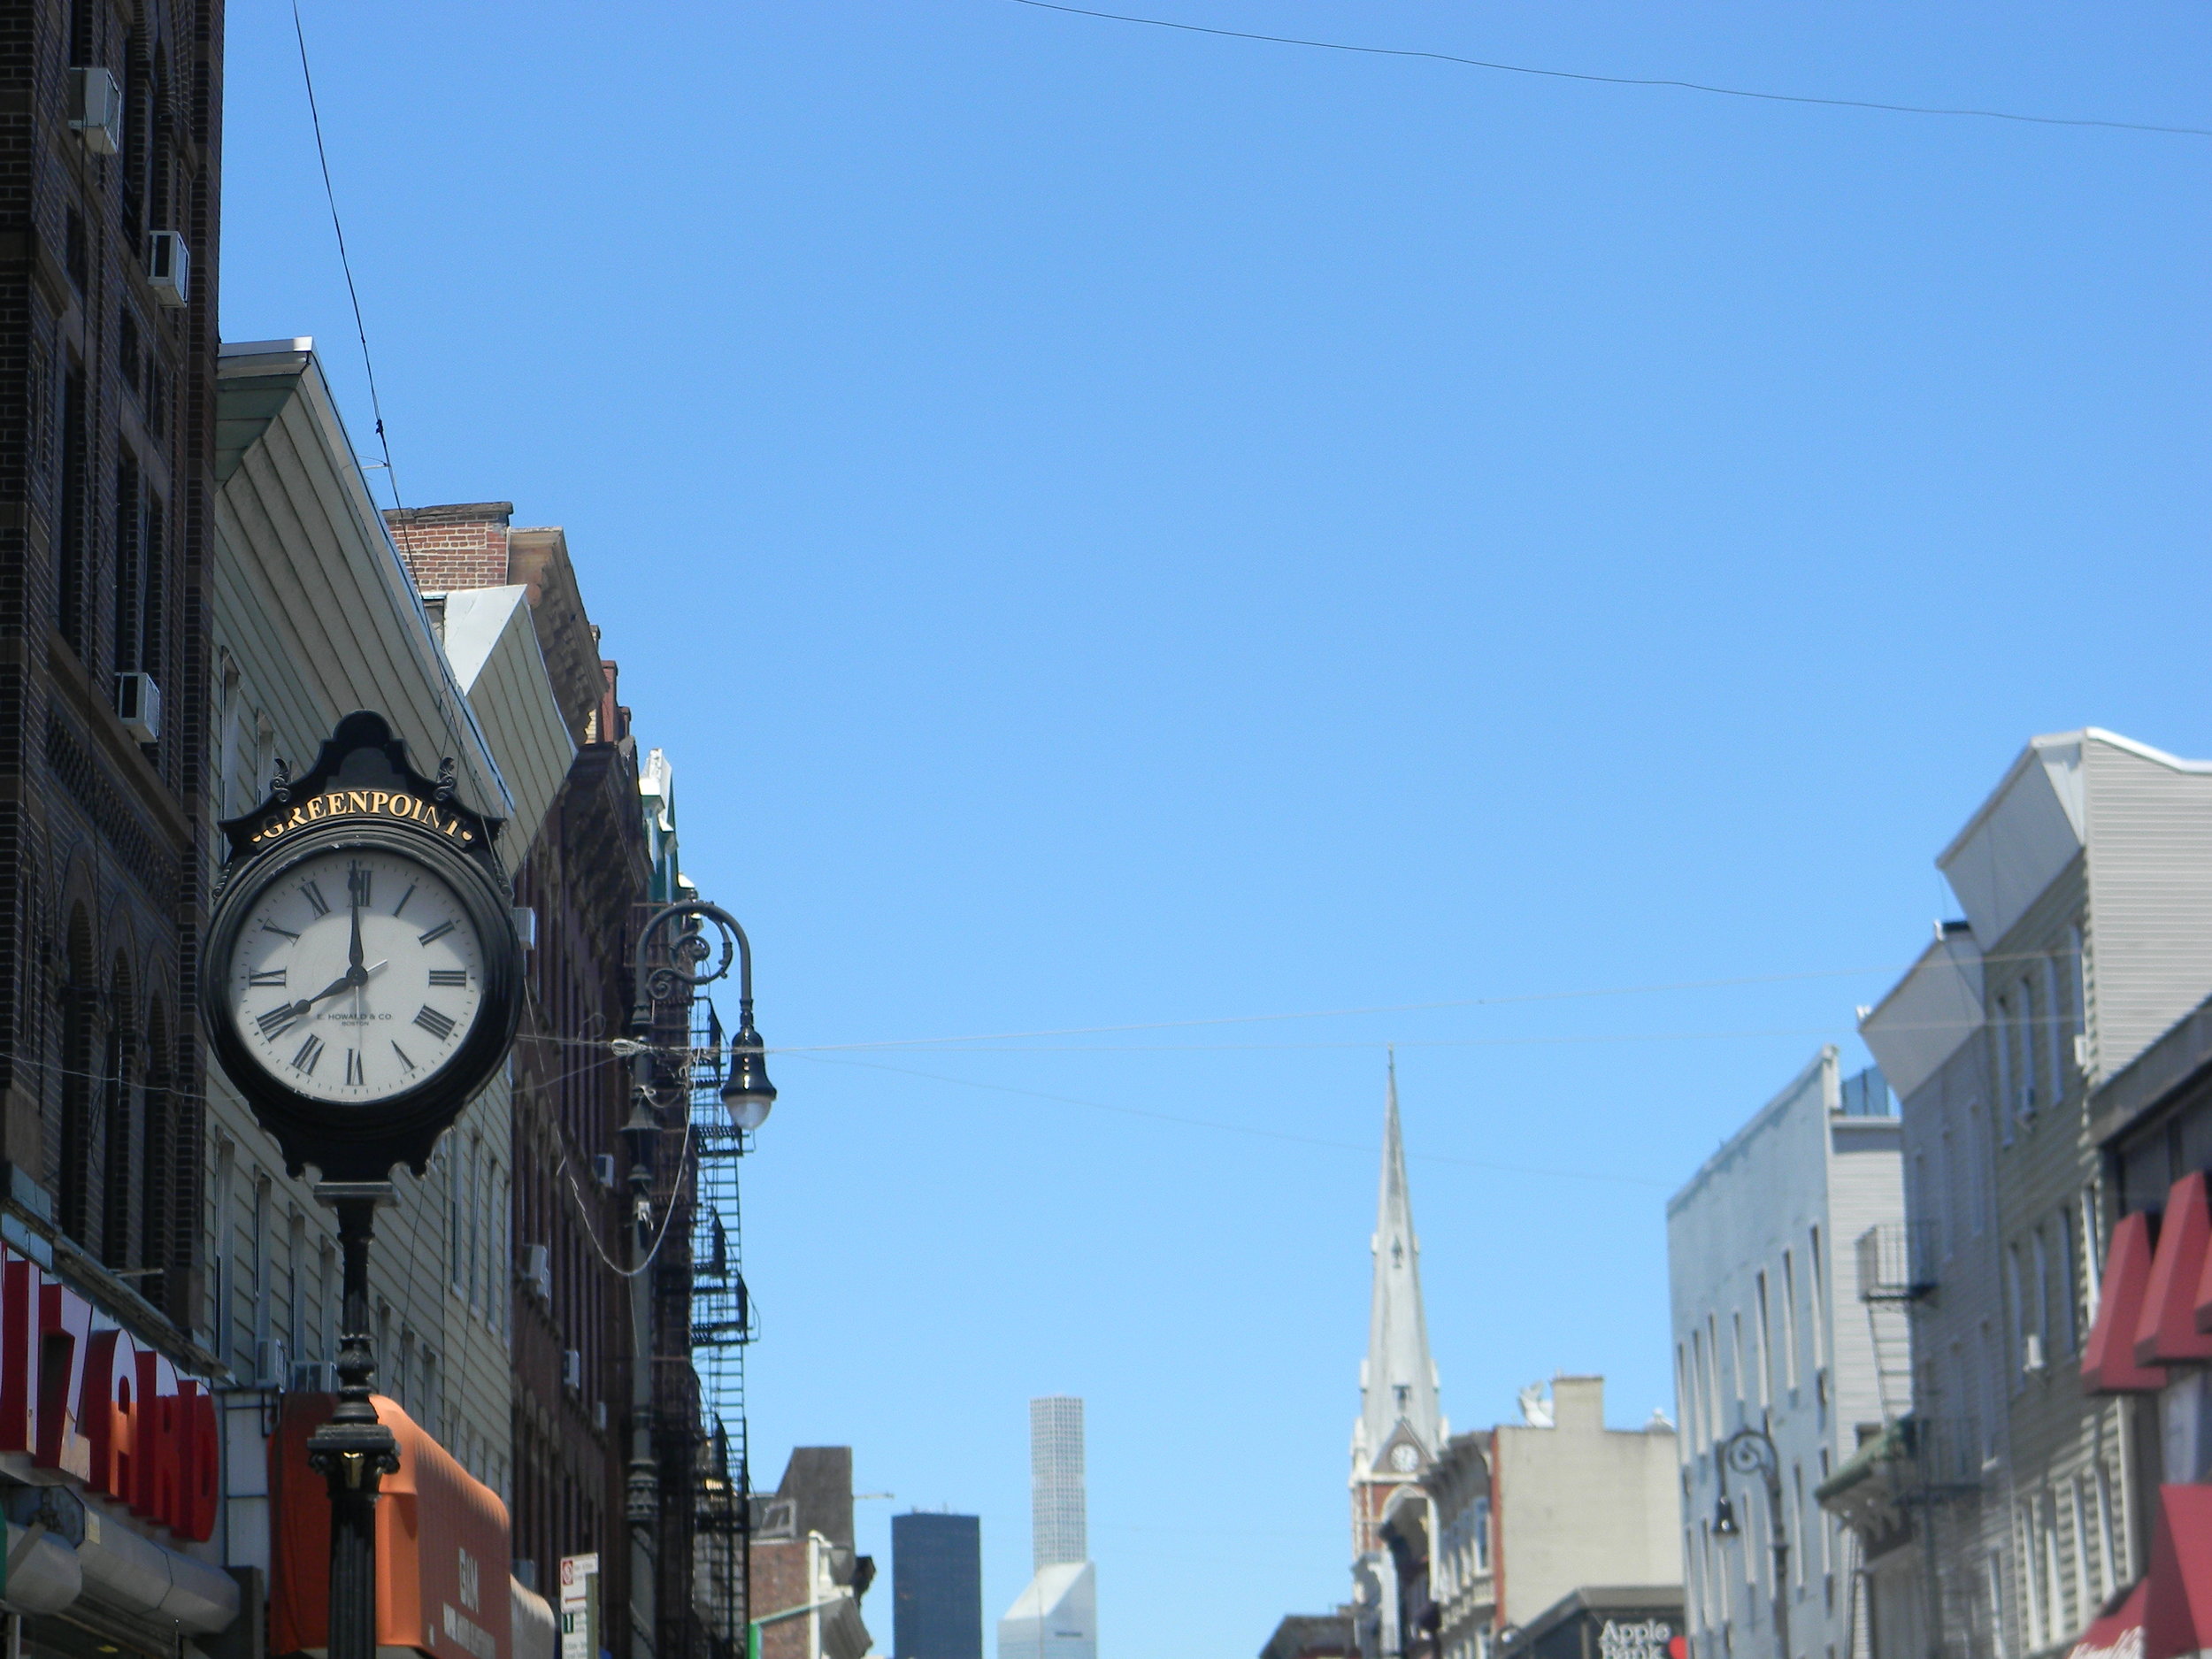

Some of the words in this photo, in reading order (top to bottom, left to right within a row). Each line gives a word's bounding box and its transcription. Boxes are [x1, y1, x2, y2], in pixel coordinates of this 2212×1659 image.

[262, 790, 467, 838] GREENPOINT
[347, 870, 373, 908] II
[428, 967, 467, 991] III
[0, 1242, 219, 1542] IZARD
[1598, 1618, 1672, 1647] Apple
